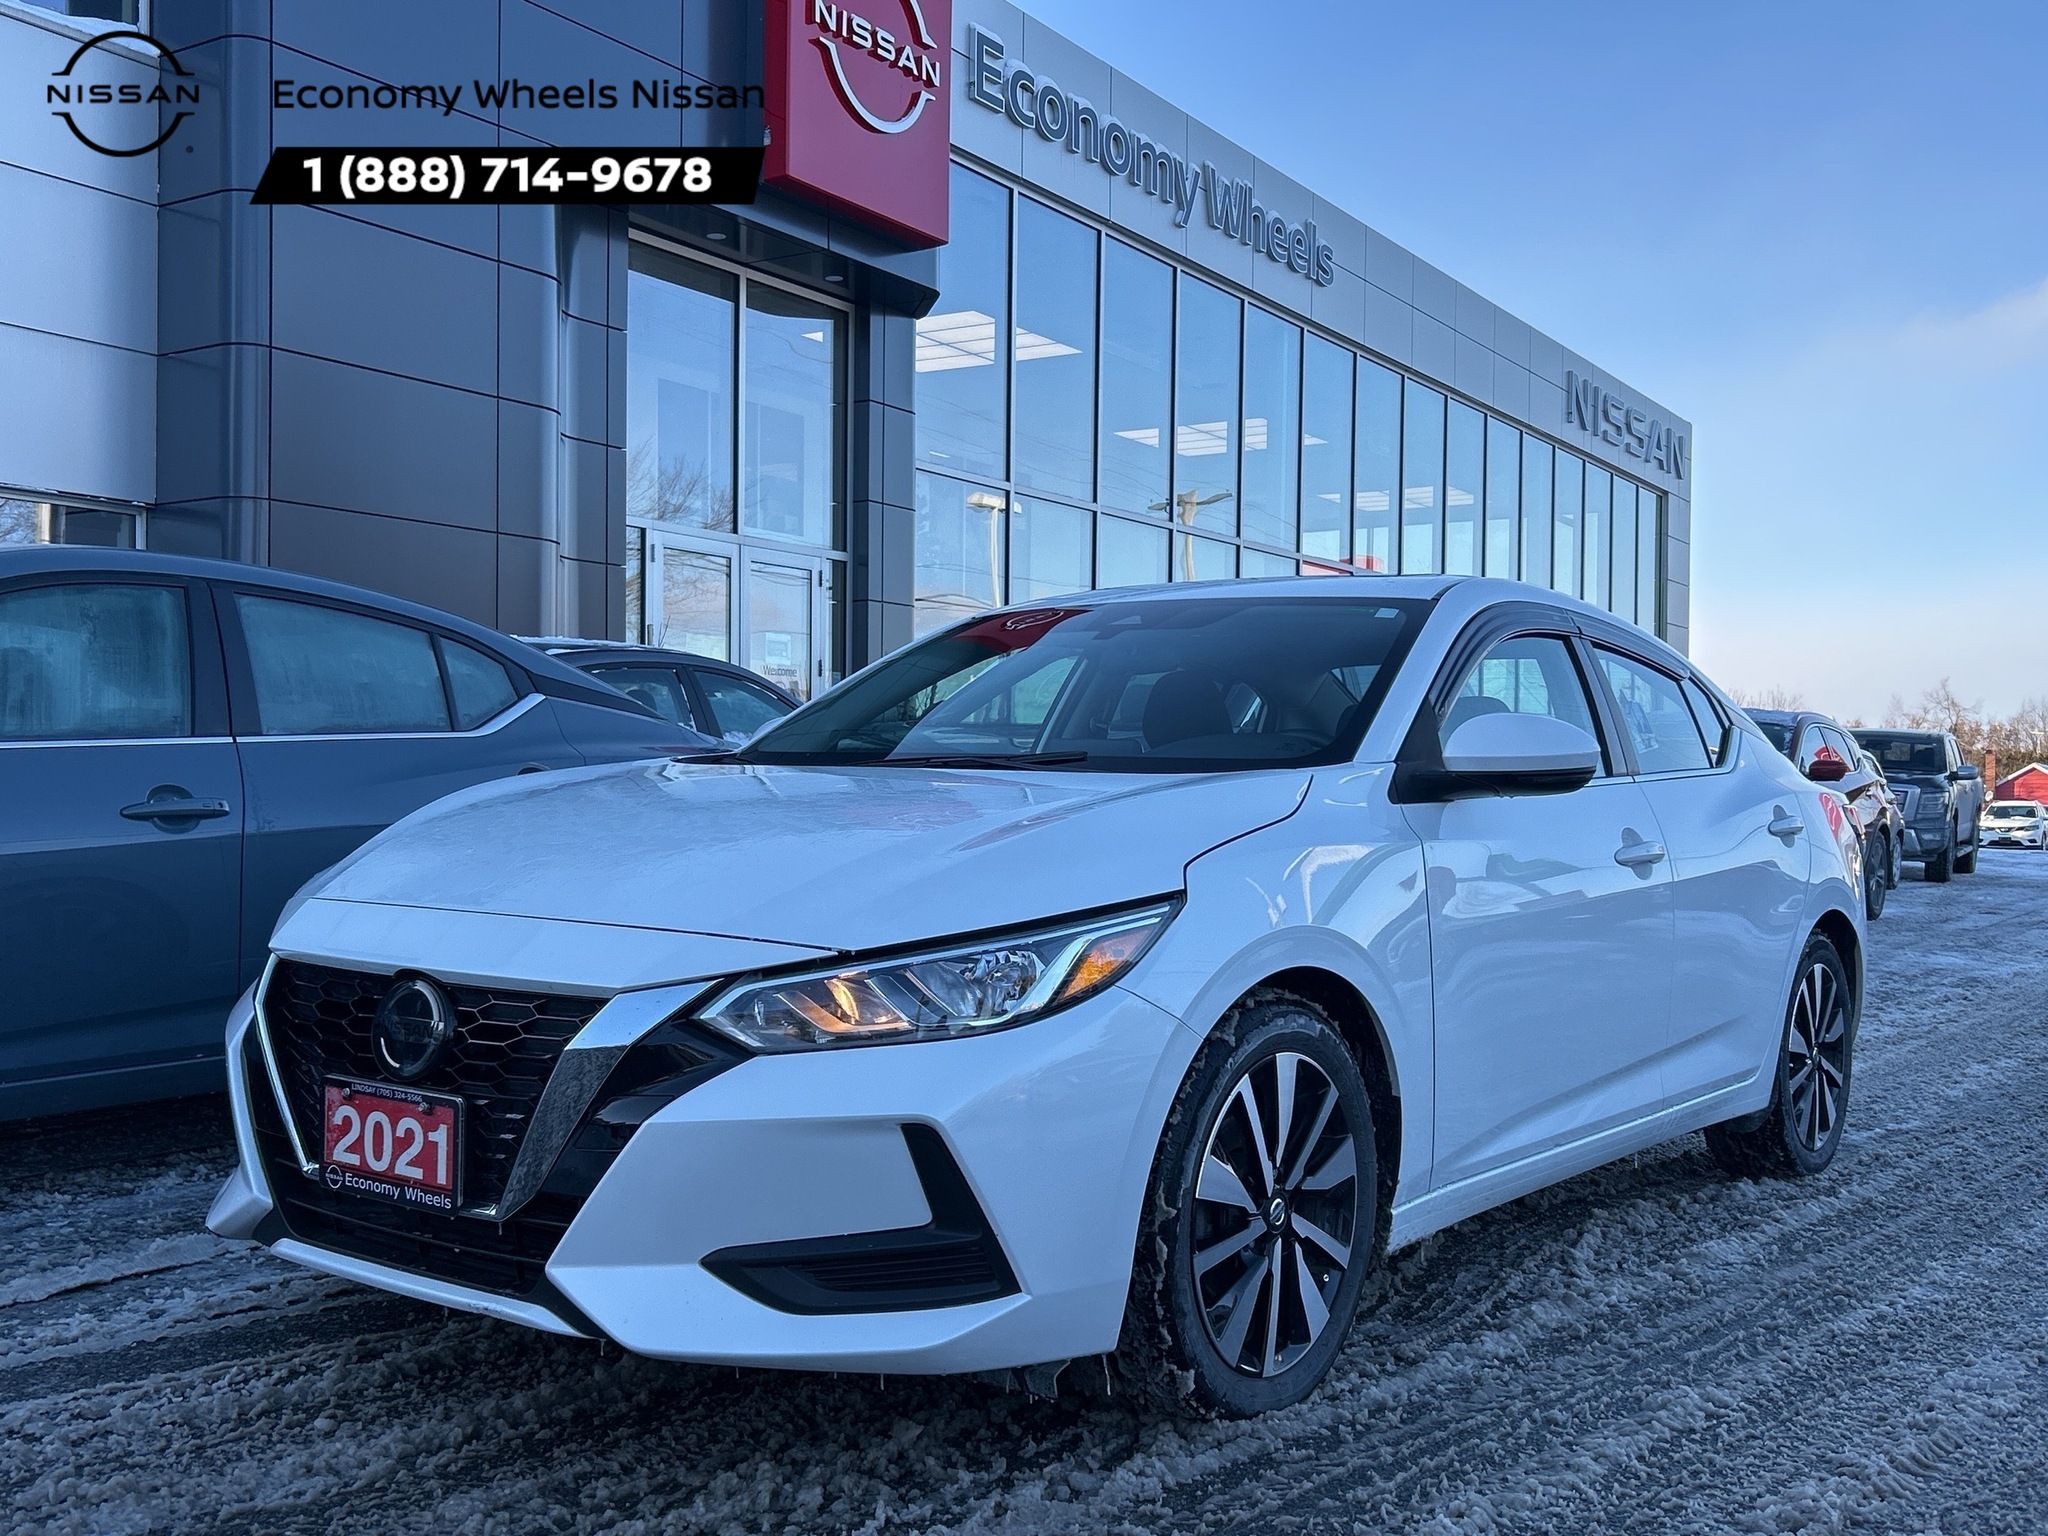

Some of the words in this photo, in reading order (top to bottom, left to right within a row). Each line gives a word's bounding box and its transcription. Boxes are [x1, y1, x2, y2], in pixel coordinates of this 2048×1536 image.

[813, 0, 941, 88] NISSAN
[969, 23, 1200, 228] Economy
[1204, 162, 1335, 288] Wheels
[1567, 370, 1686, 480] NISSAN
[351, 1083, 376, 1093] LINDSAY
[376, 1088, 393, 1098] (705)
[333, 1105, 448, 1185] 2021
[345, 1172, 400, 1199] Economy
[404, 1186, 452, 1209] Wheels
